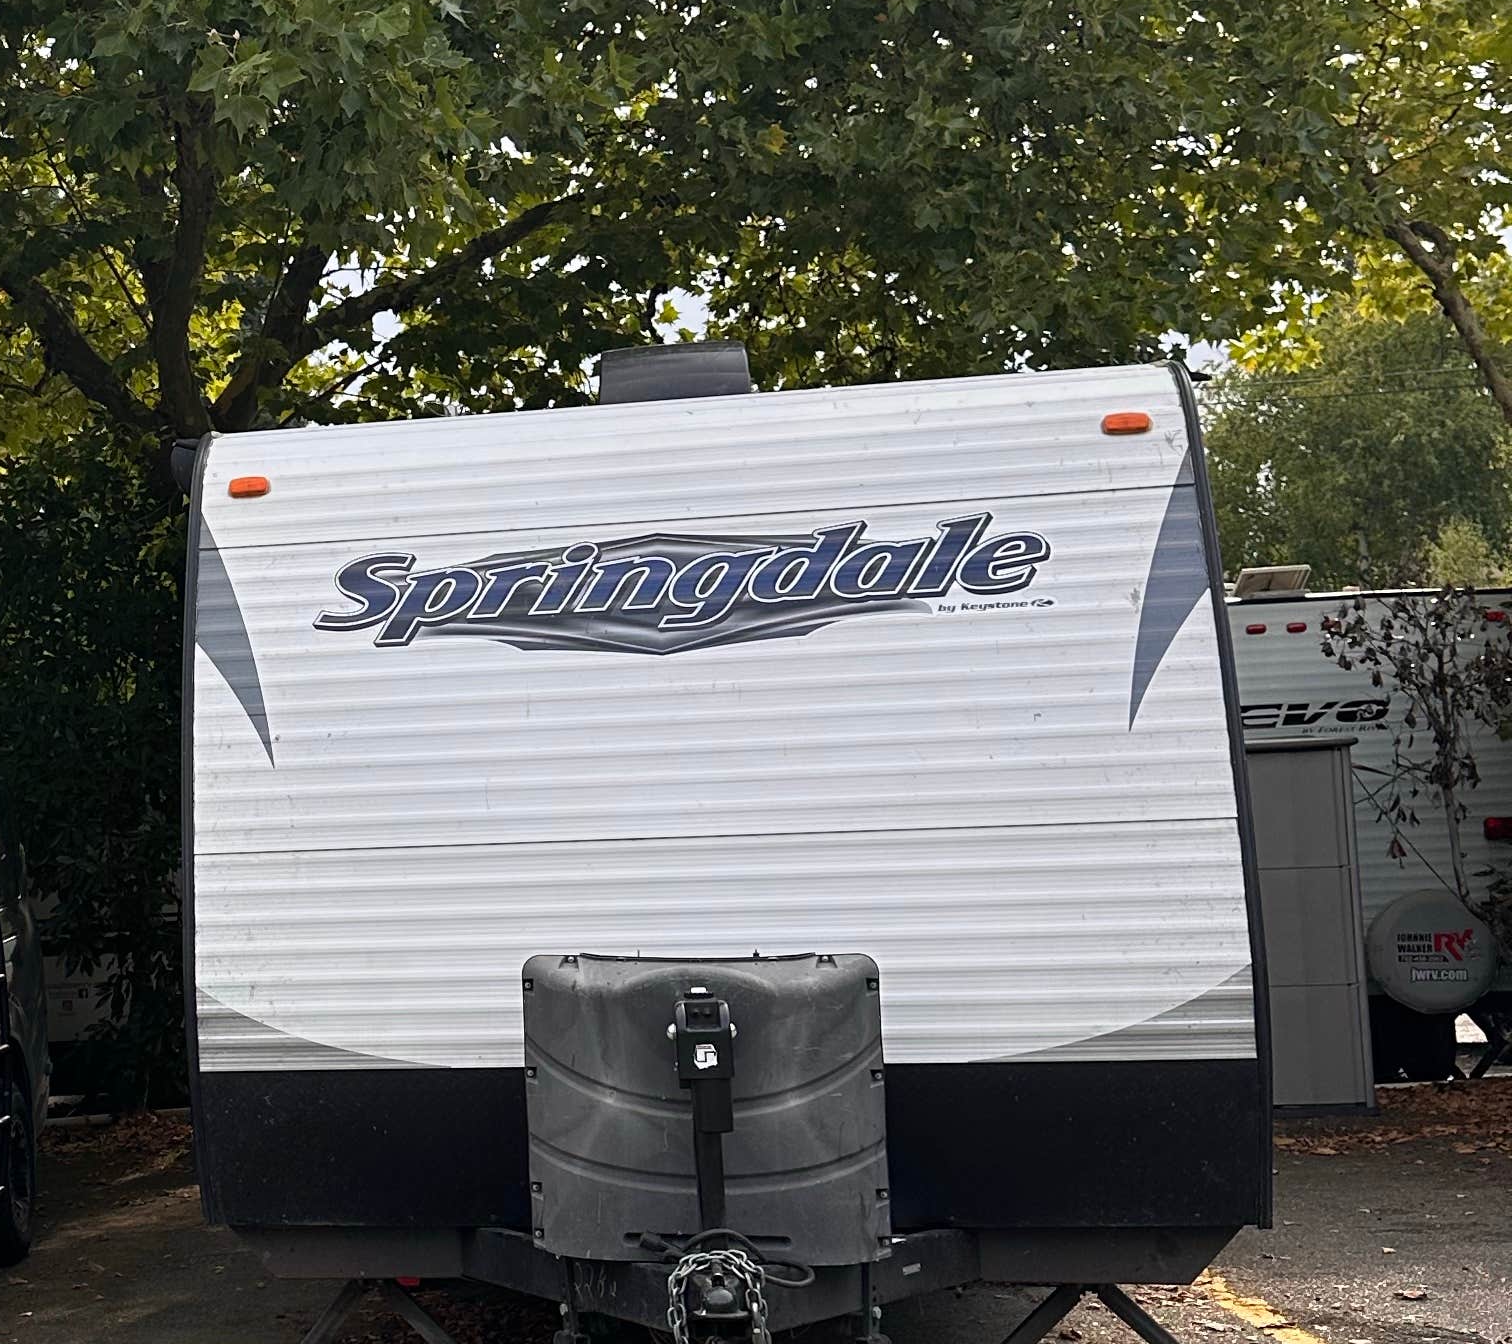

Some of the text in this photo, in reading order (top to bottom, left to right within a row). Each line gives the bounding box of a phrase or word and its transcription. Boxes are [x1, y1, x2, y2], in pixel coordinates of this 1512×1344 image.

[314, 512, 1051, 646] Springdale
[938, 600, 1028, 613] by Keystone
[1397, 944, 1433, 953] WALKER
